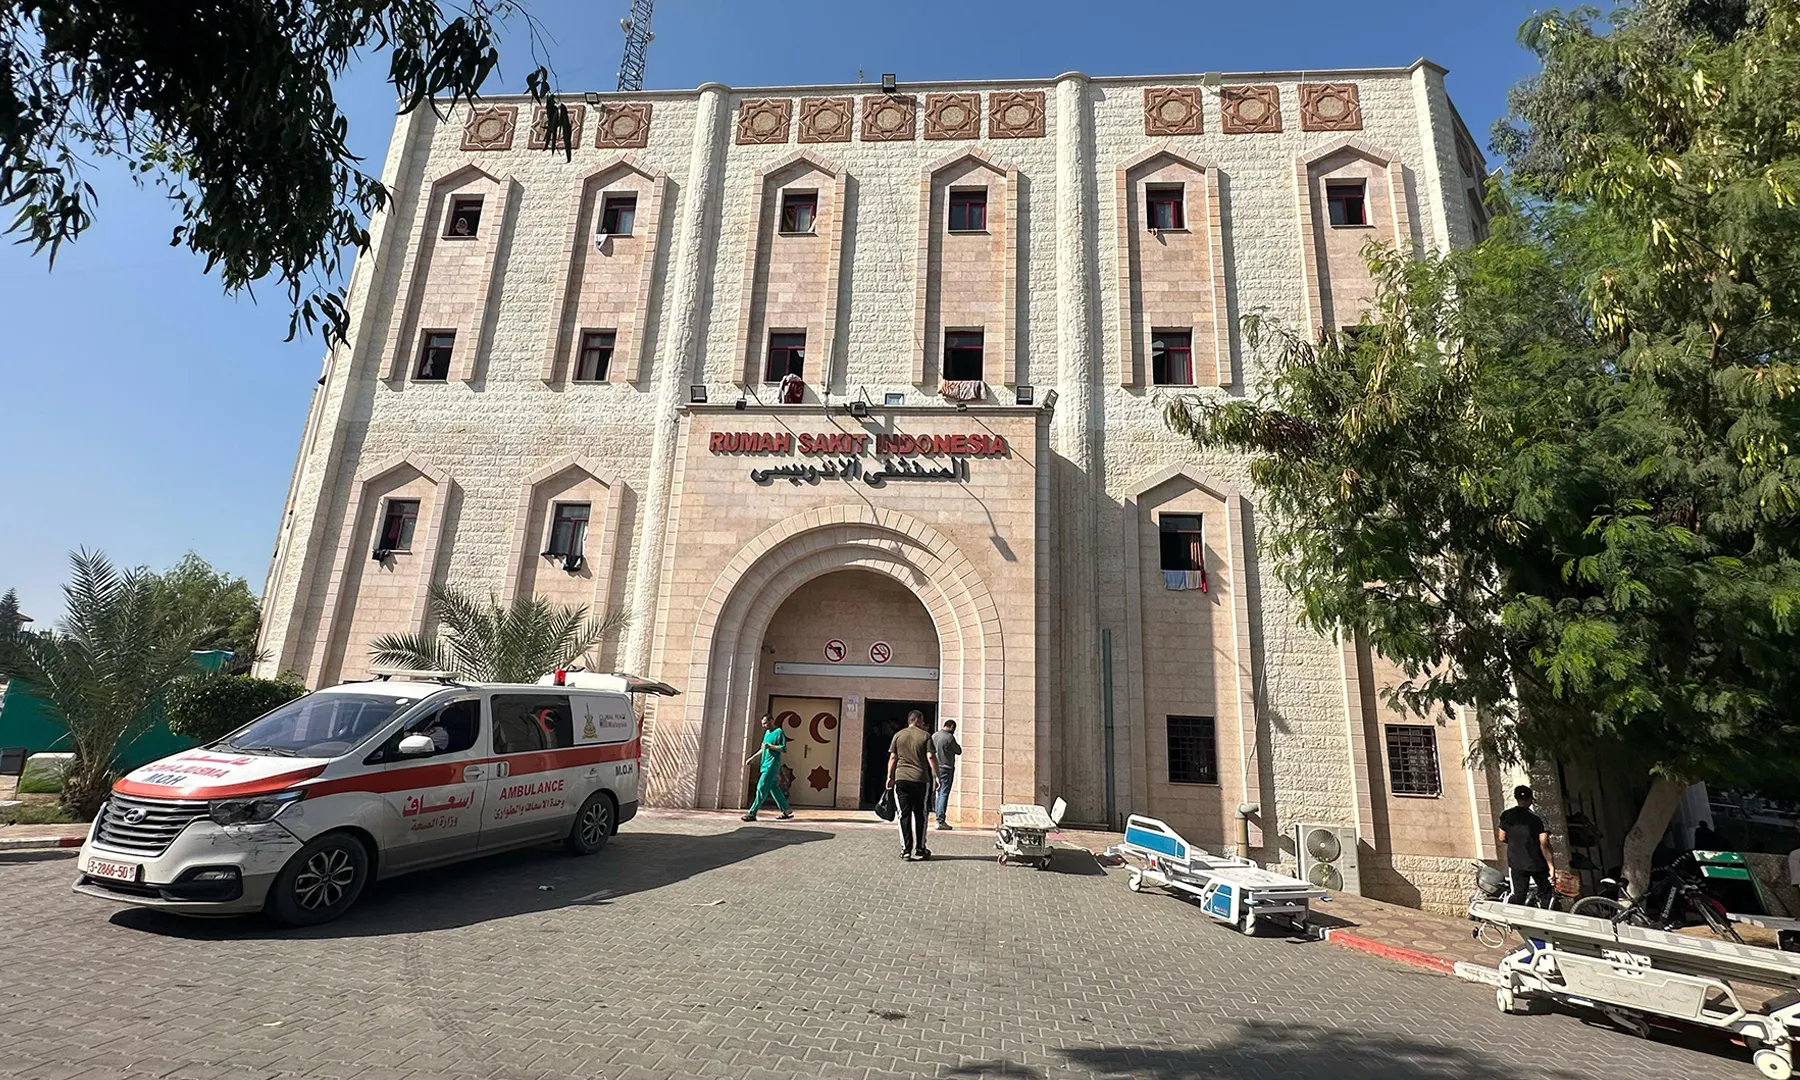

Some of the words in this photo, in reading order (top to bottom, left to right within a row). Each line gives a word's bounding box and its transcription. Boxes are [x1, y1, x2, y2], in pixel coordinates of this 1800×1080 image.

[708, 431, 792, 454] RUMAH
[797, 432, 868, 456] SAKIT
[875, 433, 1008, 457] INDONESIA
[615, 763, 633, 777] M.O.H
[499, 779, 565, 801] AMBULANCE
[402, 789, 476, 818] إسعاف
